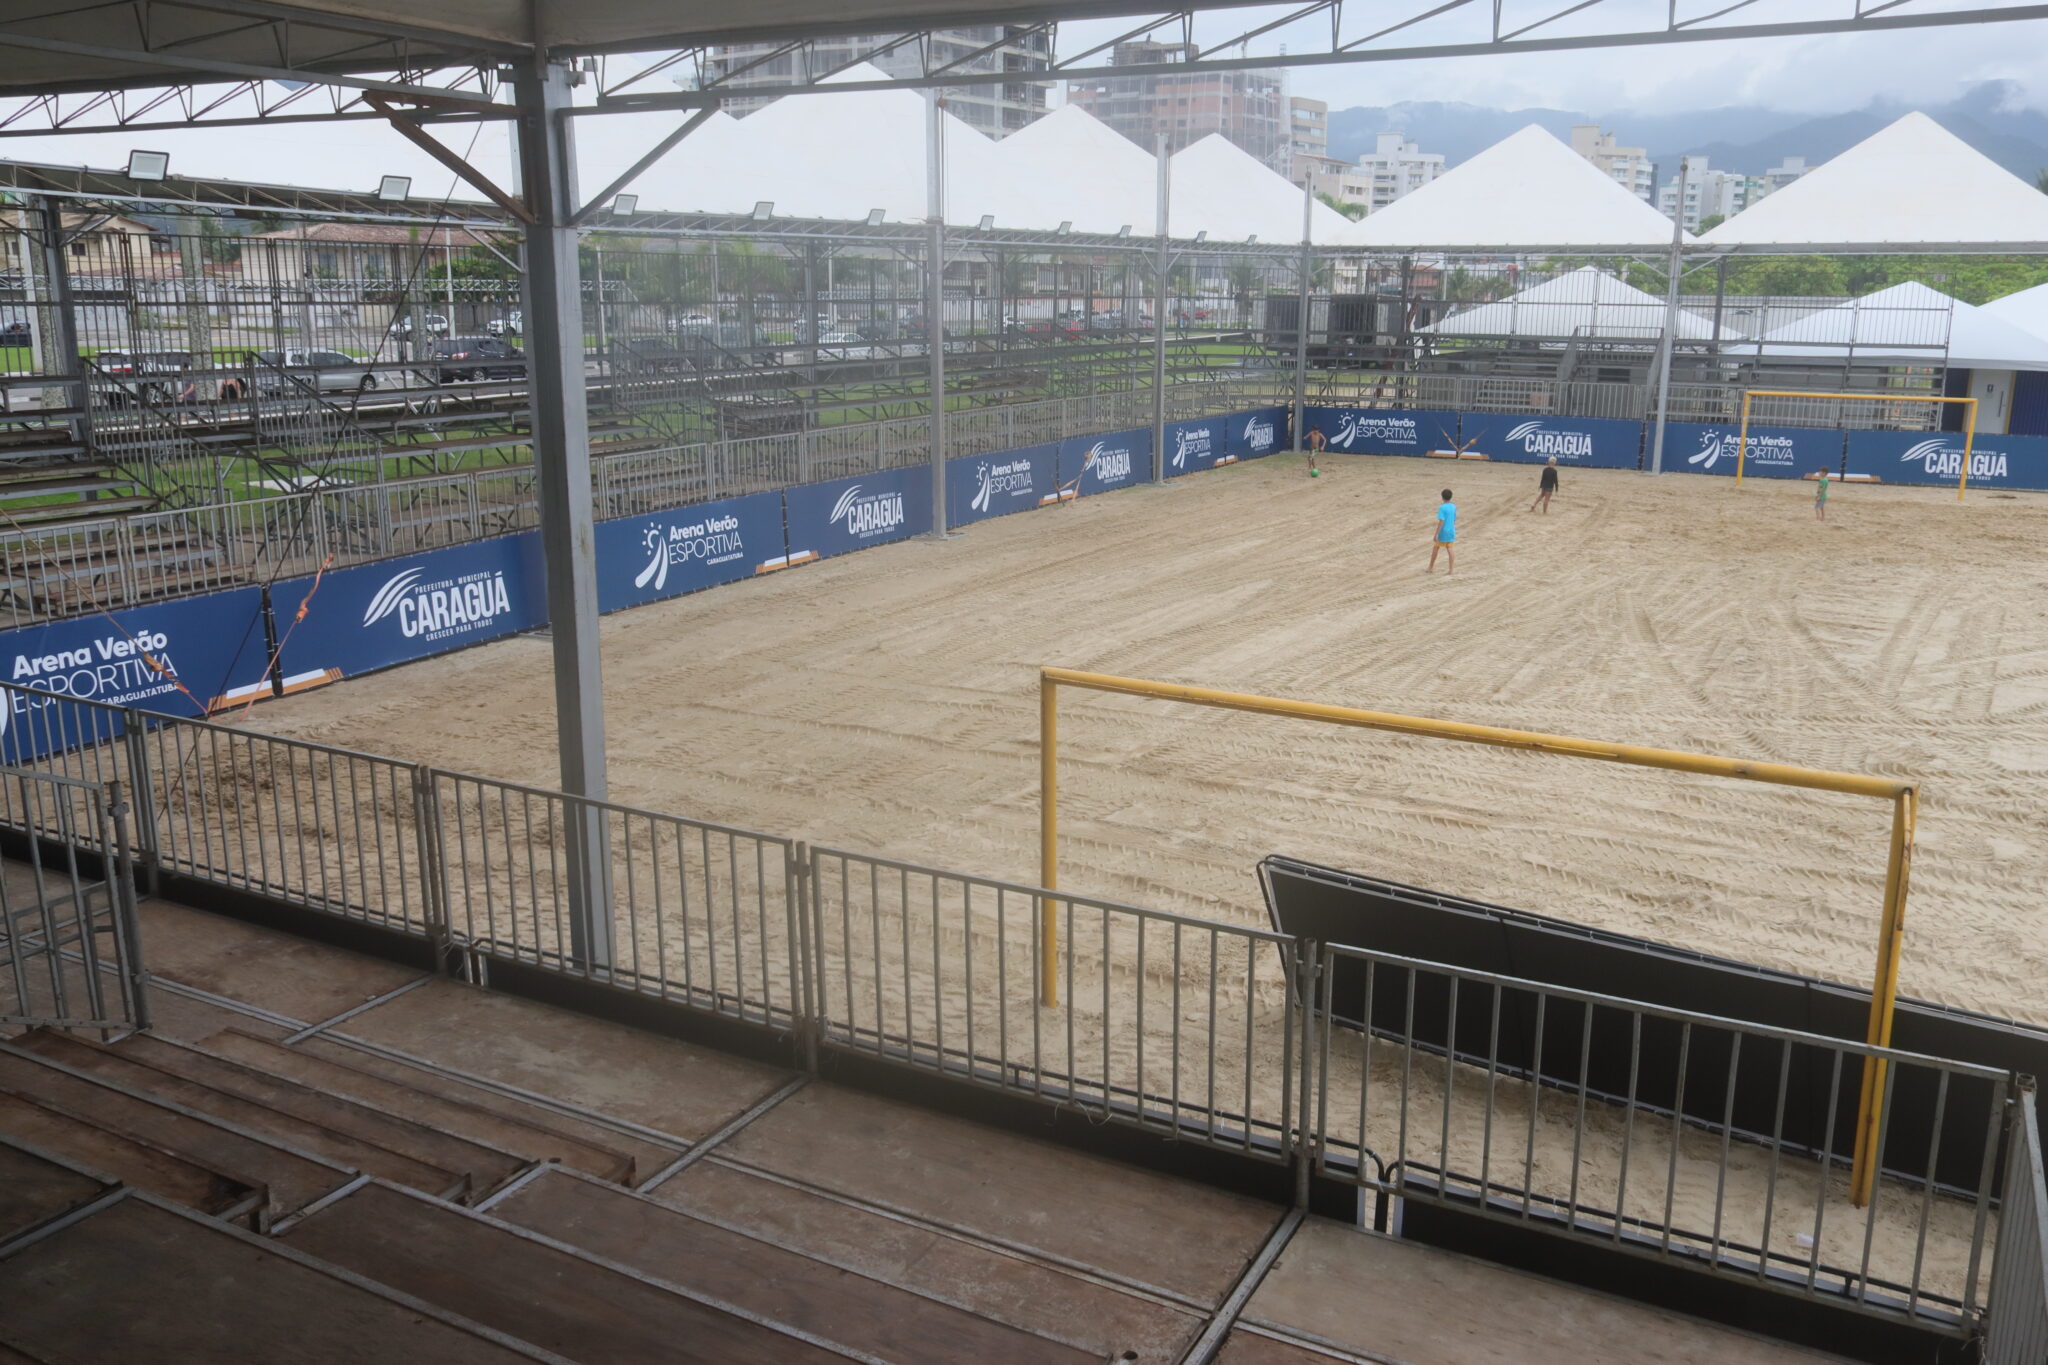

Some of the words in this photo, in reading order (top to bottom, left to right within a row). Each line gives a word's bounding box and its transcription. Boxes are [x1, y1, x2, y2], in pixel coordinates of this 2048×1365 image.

[1356, 426, 1417, 439] ESPORTIVA
[1359, 417, 1386, 426] Arena
[1388, 418, 1415, 428] Verão
[1525, 434, 1592, 456] CARAGUÁ
[1760, 436, 1793, 447] Verão
[991, 464, 1011, 477] Arena
[1011, 459, 1031, 472] Verão
[1096, 449, 1131, 481] CARAGUÁ
[990, 472, 1033, 494] ESPORTIVA
[848, 492, 904, 535] CARAGUÁ
[670, 525, 704, 542] Arena
[705, 515, 739, 533] Verão
[668, 530, 743, 565] ESPORTIVA
[415, 580, 453, 594] PREFEITURA
[457, 571, 491, 584] MUNICIPAL
[399, 570, 511, 638] CARAGUÁ
[12, 648, 92, 679] Arena
[94, 630, 168, 660] Verão
